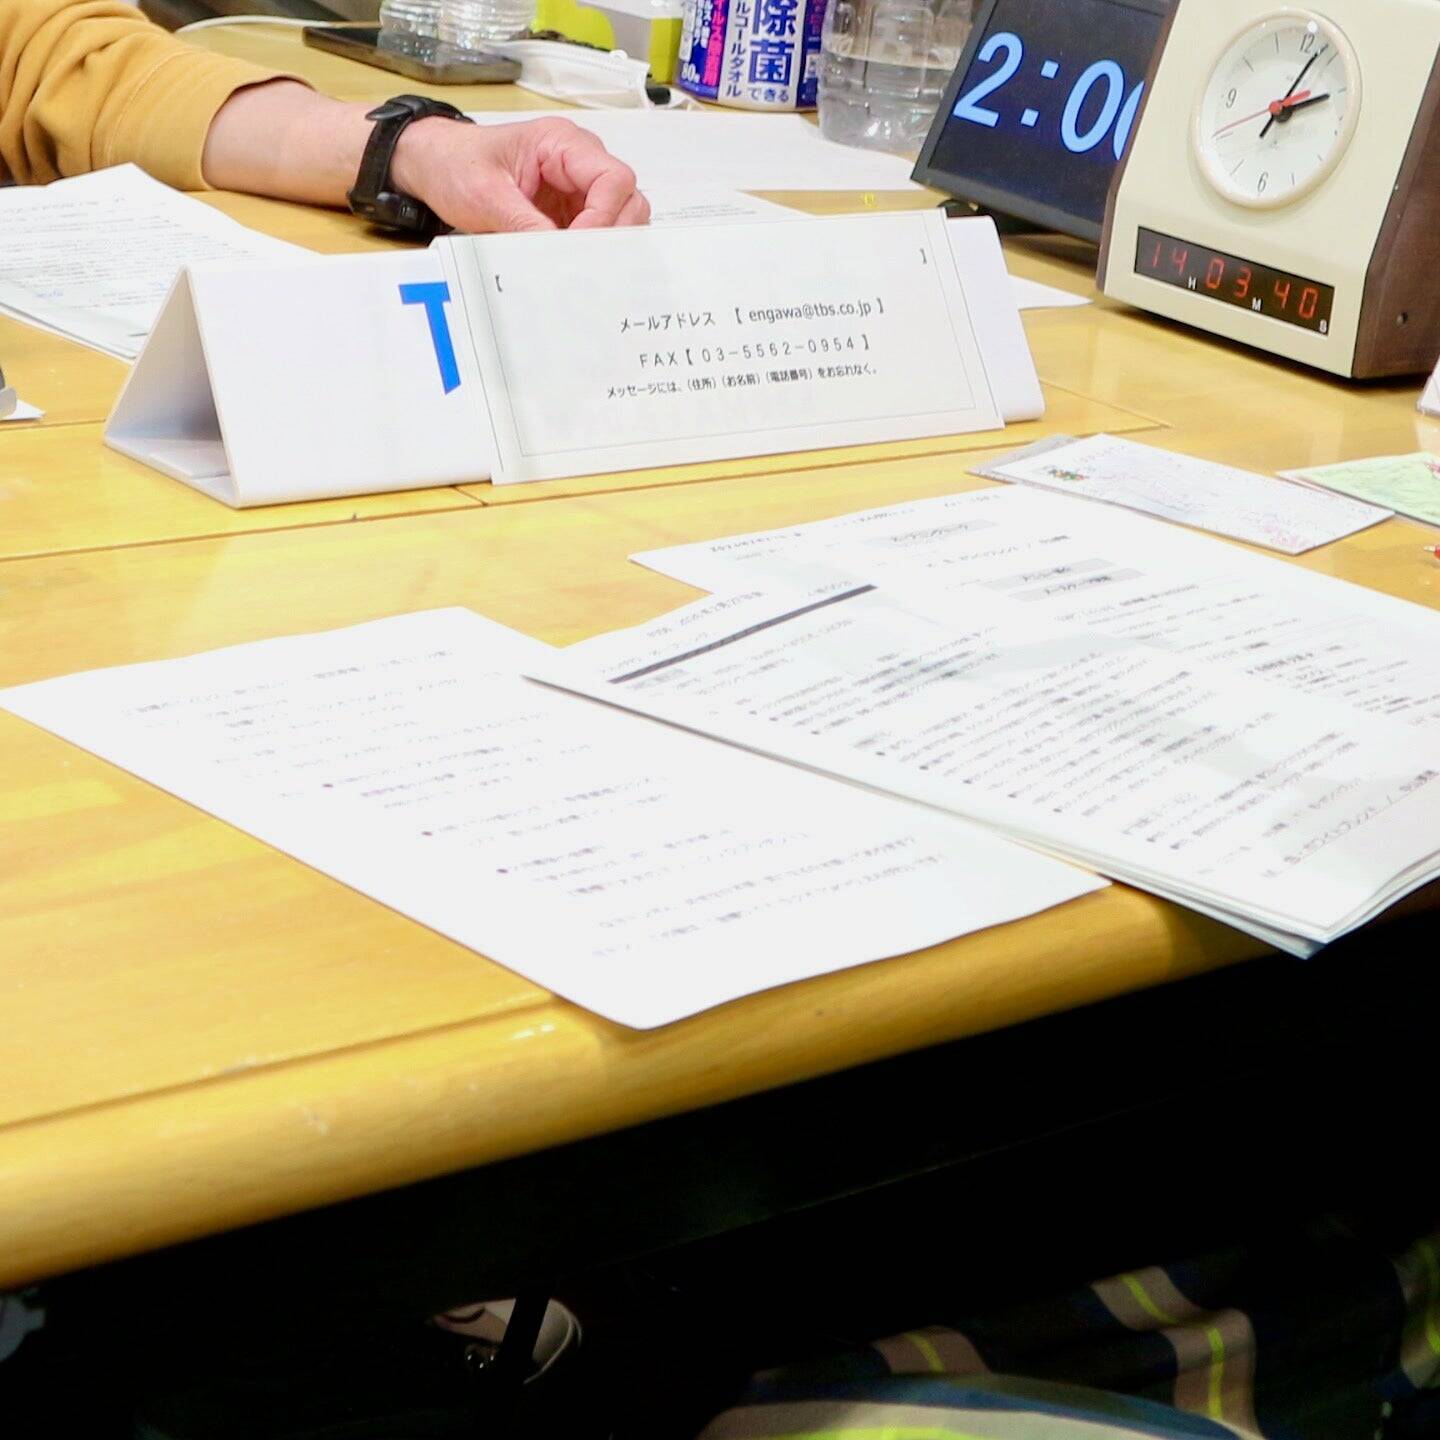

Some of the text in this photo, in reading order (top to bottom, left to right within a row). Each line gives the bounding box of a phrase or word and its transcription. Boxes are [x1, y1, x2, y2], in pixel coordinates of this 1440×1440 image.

[1299, 32, 1316, 54] 12
[1226, 88, 1238, 108] 9
[1257, 172, 1269, 193] 6
[1205, 257, 1253, 299] 03
[1273, 278, 1320, 320] 40
[620, 311, 716, 333] メールアドレス
